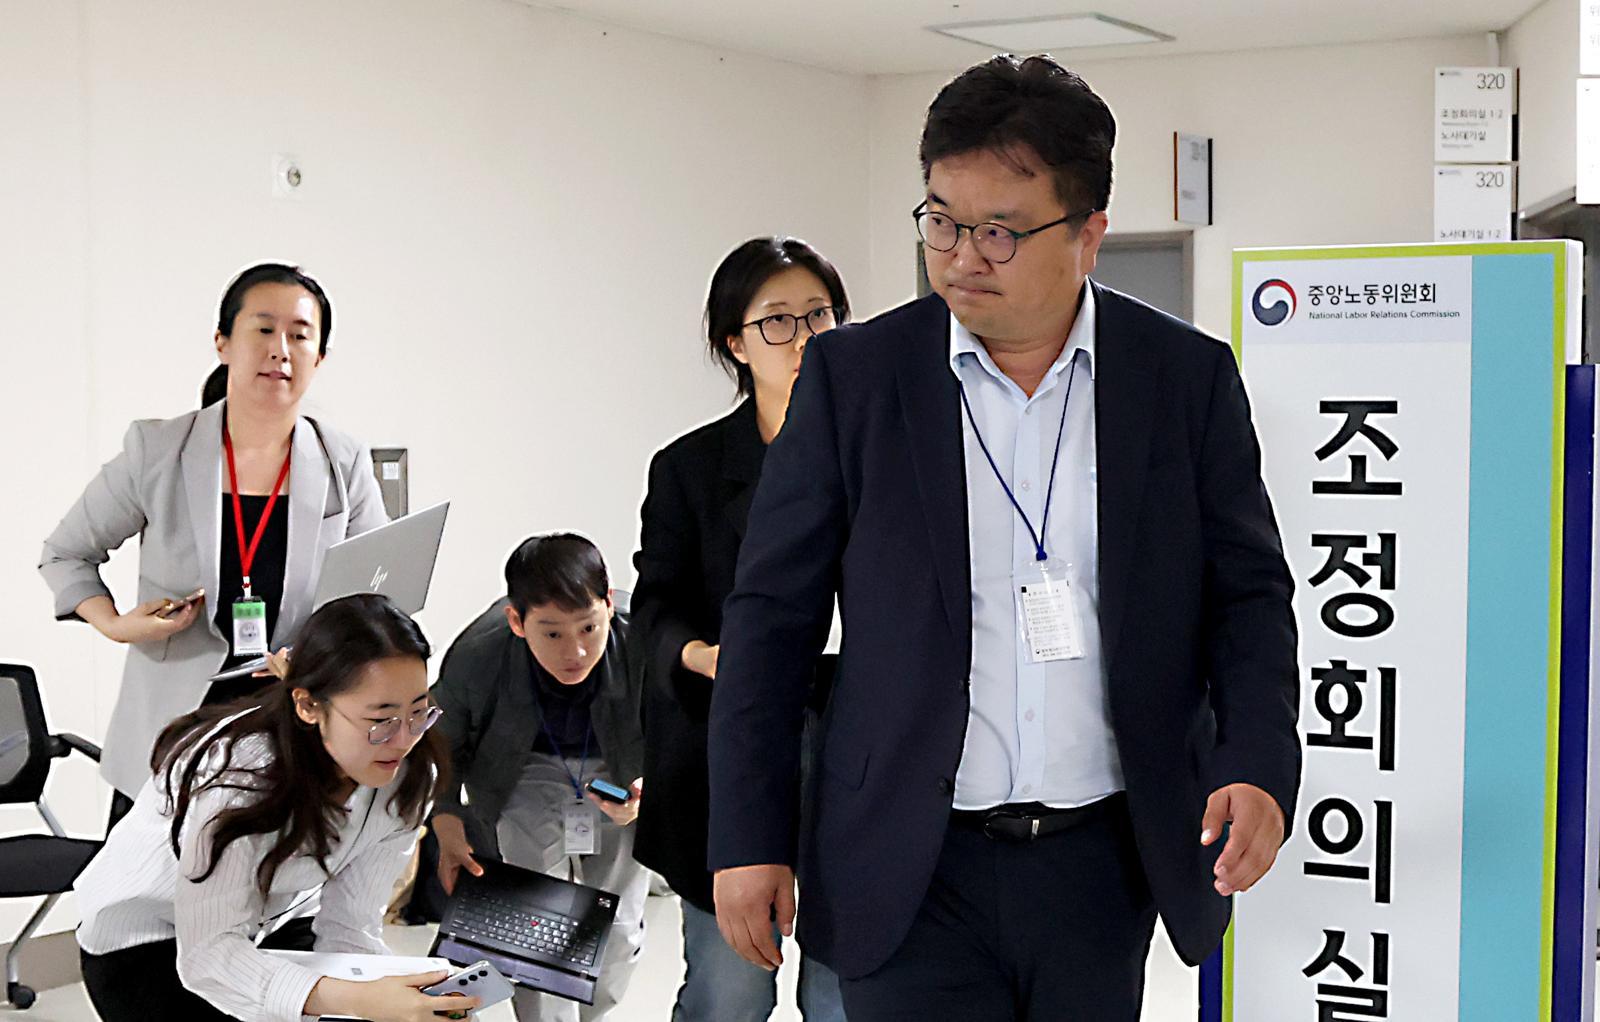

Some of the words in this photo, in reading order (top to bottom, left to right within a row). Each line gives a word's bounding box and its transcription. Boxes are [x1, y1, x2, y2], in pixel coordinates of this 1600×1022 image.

[1476, 73, 1505, 90] 320
[1476, 171, 1504, 188] 320
[1307, 283, 1436, 306] 중앙노동위원회
[1308, 311, 1343, 320] National
[1345, 311, 1368, 319] Labor
[1370, 310, 1408, 319] Relations
[1410, 310, 1460, 319] Commission
[1301, 399, 1403, 1022] 조정회의실
